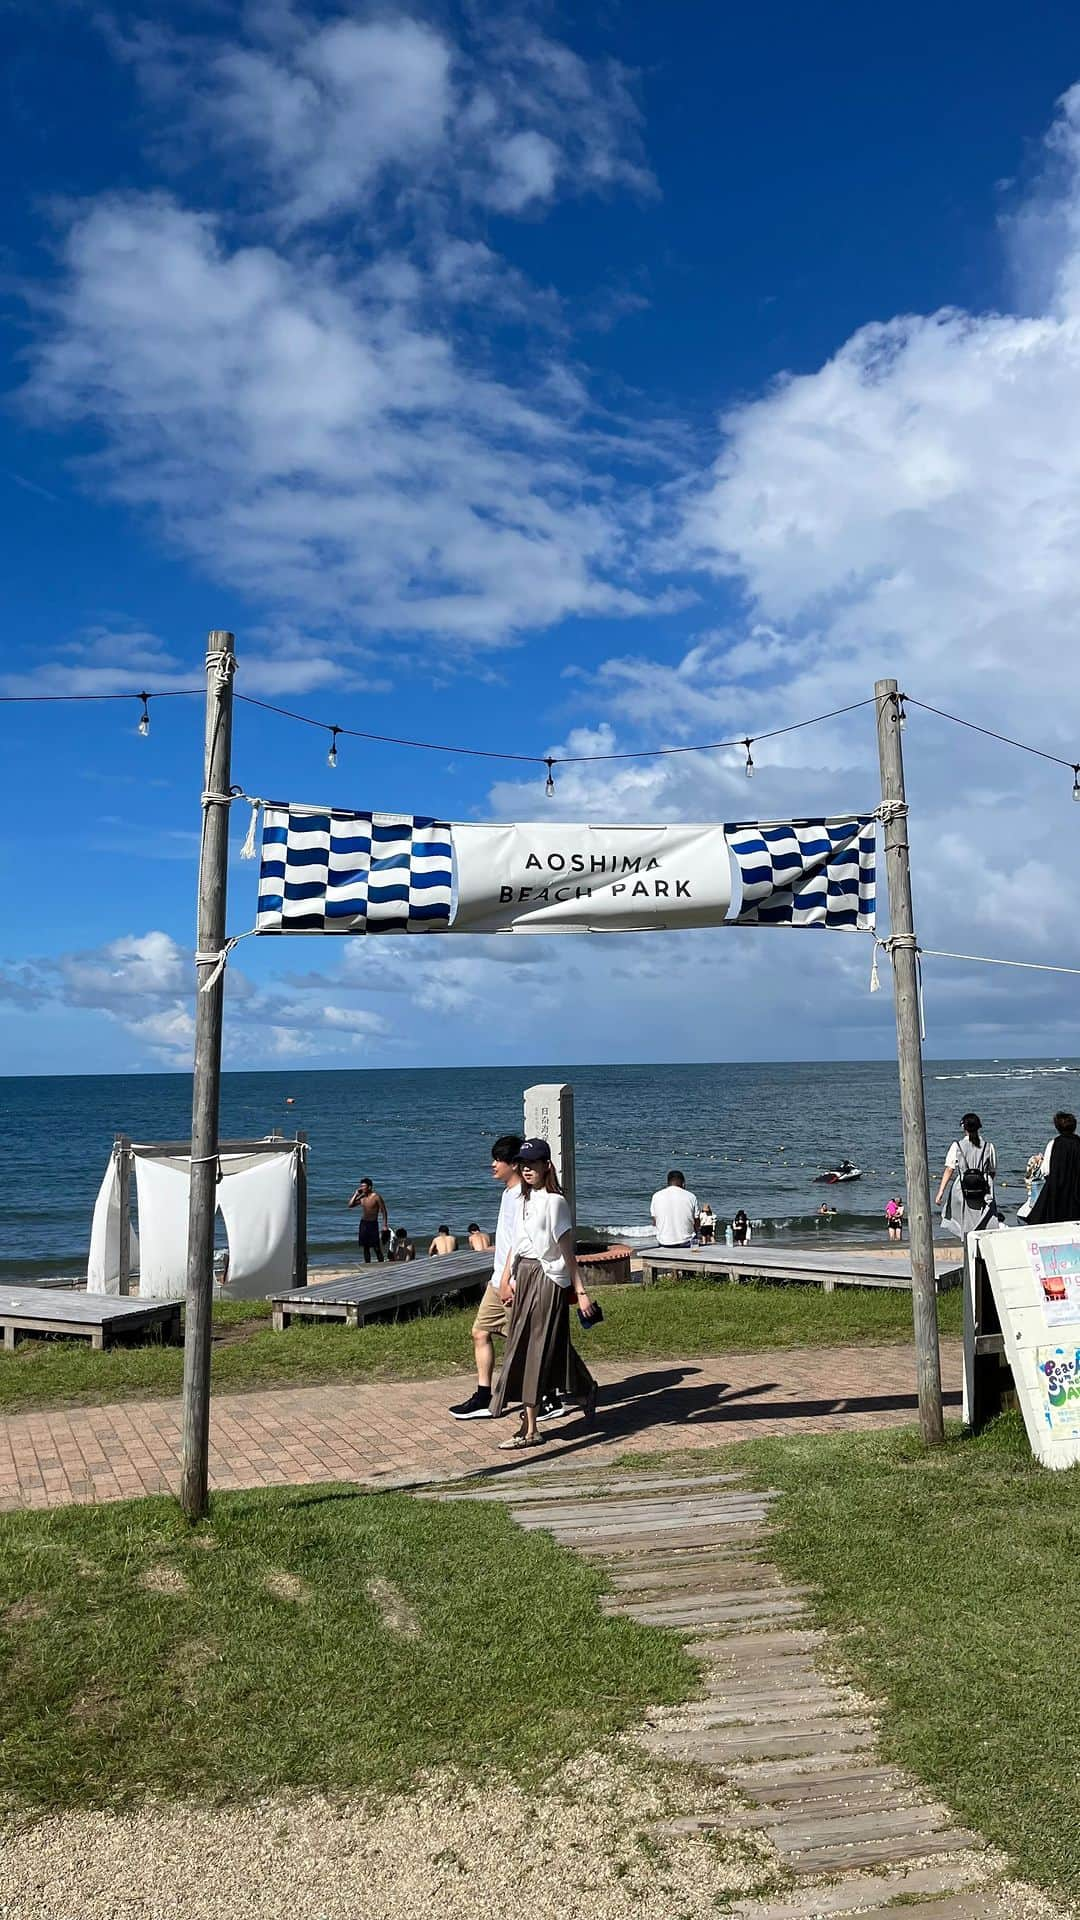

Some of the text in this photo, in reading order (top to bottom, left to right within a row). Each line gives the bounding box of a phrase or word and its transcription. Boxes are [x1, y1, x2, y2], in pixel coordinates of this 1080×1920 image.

[525, 853, 663, 873] AOSHIMA
[499, 880, 692, 903] BEACH PARK
[1048, 1374, 1080, 1391] Summe
